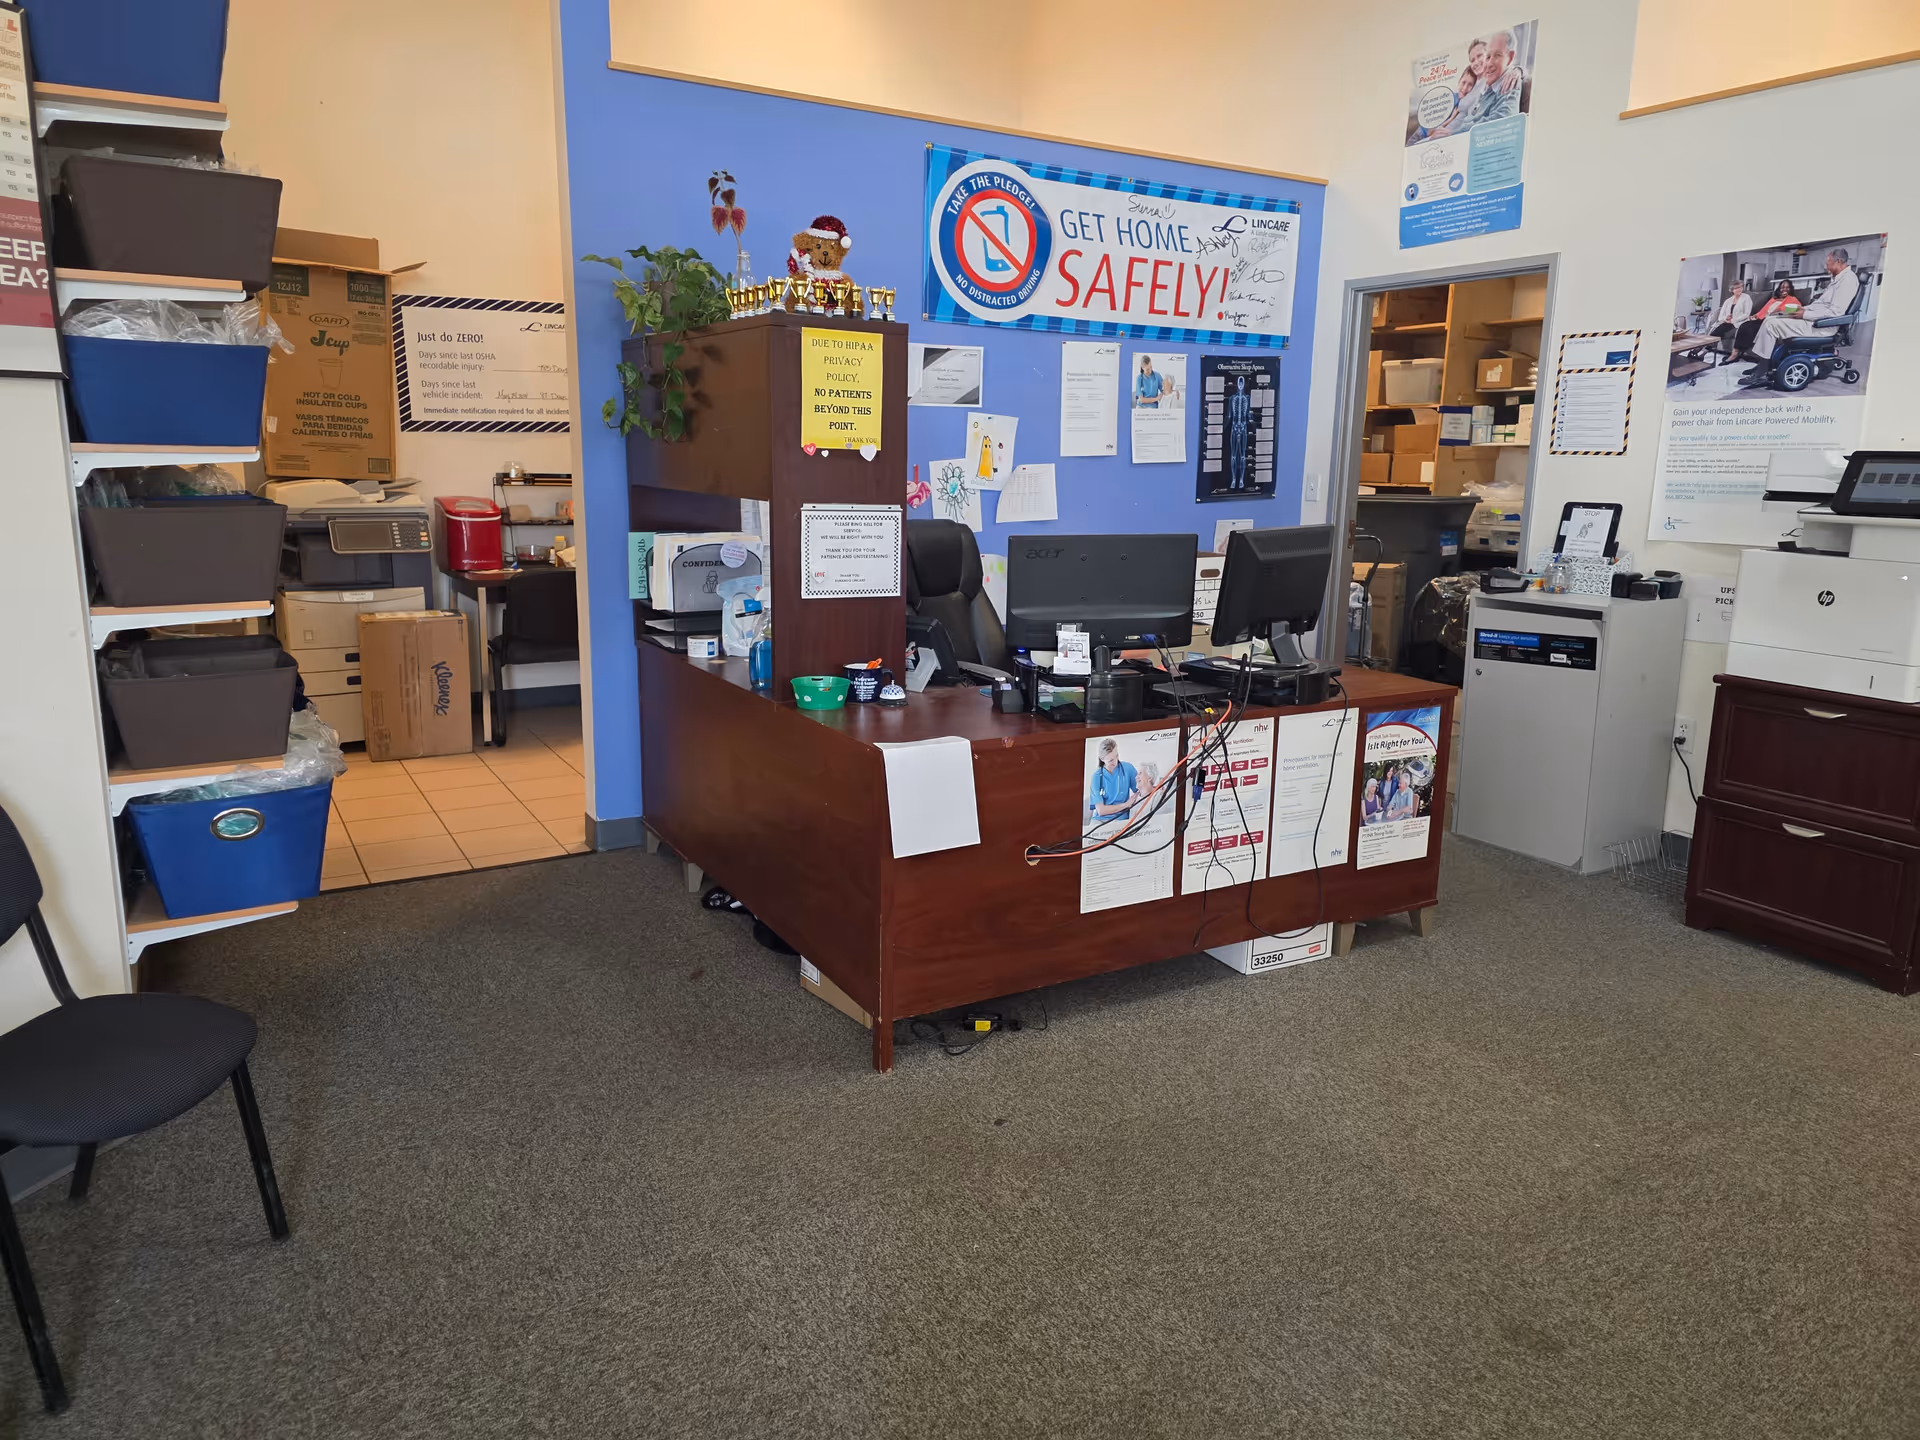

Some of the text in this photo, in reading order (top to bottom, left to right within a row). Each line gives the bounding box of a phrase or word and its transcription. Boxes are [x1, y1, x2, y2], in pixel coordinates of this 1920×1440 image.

[947, 175, 1035, 215] TAKE THE PLEDGE!
[1060, 208, 1193, 253] GET HOME
[1251, 218, 1290, 232] LINCARE
[350, 282, 369, 292] 1000
[955, 268, 1041, 306] NO DISTRACTED DRIVING
[1055, 249, 1230, 320] SAFELY!
[314, 315, 344, 325] DART
[417, 332, 484, 344] Just do ZERO!
[812, 338, 874, 351] DUE TO HIPAA
[419, 351, 496, 361] Days since last OSHA
[824, 356, 863, 366] PRIVACY
[420, 361, 485, 372] recordable injury:
[421, 380, 476, 390] Days since last
[338, 394, 360, 402] COLD
[422, 390, 483, 399] vehicle incident:
[814, 387, 872, 399] NO PATIENTS
[296, 399, 368, 410] INSULATED CUPS
[814, 404, 872, 415] BEYOND THIS
[1673, 408, 1690, 416] Gain
[1709, 405, 1763, 416] independence
[1765, 404, 1784, 413] back
[1786, 404, 1804, 412] with
[296, 414, 323, 422] VASOS
[424, 407, 459, 415] Immediate
[460, 407, 497, 415] notification
[498, 408, 525, 418] required
[526, 408, 535, 416] for
[536, 408, 545, 416] all
[303, 422, 363, 432] PARA BEBIDAS
[829, 421, 857, 431] POINT.
[1671, 420, 1695, 428] power
[1696, 418, 1714, 426] chair
[1735, 417, 1763, 425] Lincare
[1765, 416, 1800, 424] Powered
[1801, 415, 1836, 424] Mobility.
[292, 429, 340, 438] CALIENTES
[1690, 434, 1709, 442] qualify
[1724, 434, 1743, 442] power
[1024, 549, 1064, 559] acer
[1819, 590, 1835, 606] hp
[431, 661, 453, 717] Kleenex
[1253, 723, 1268, 733] nhv
[1367, 736, 1427, 750] Is It Right for You?
[1331, 848, 1342, 857] nhv
[1254, 953, 1284, 966] 33250
